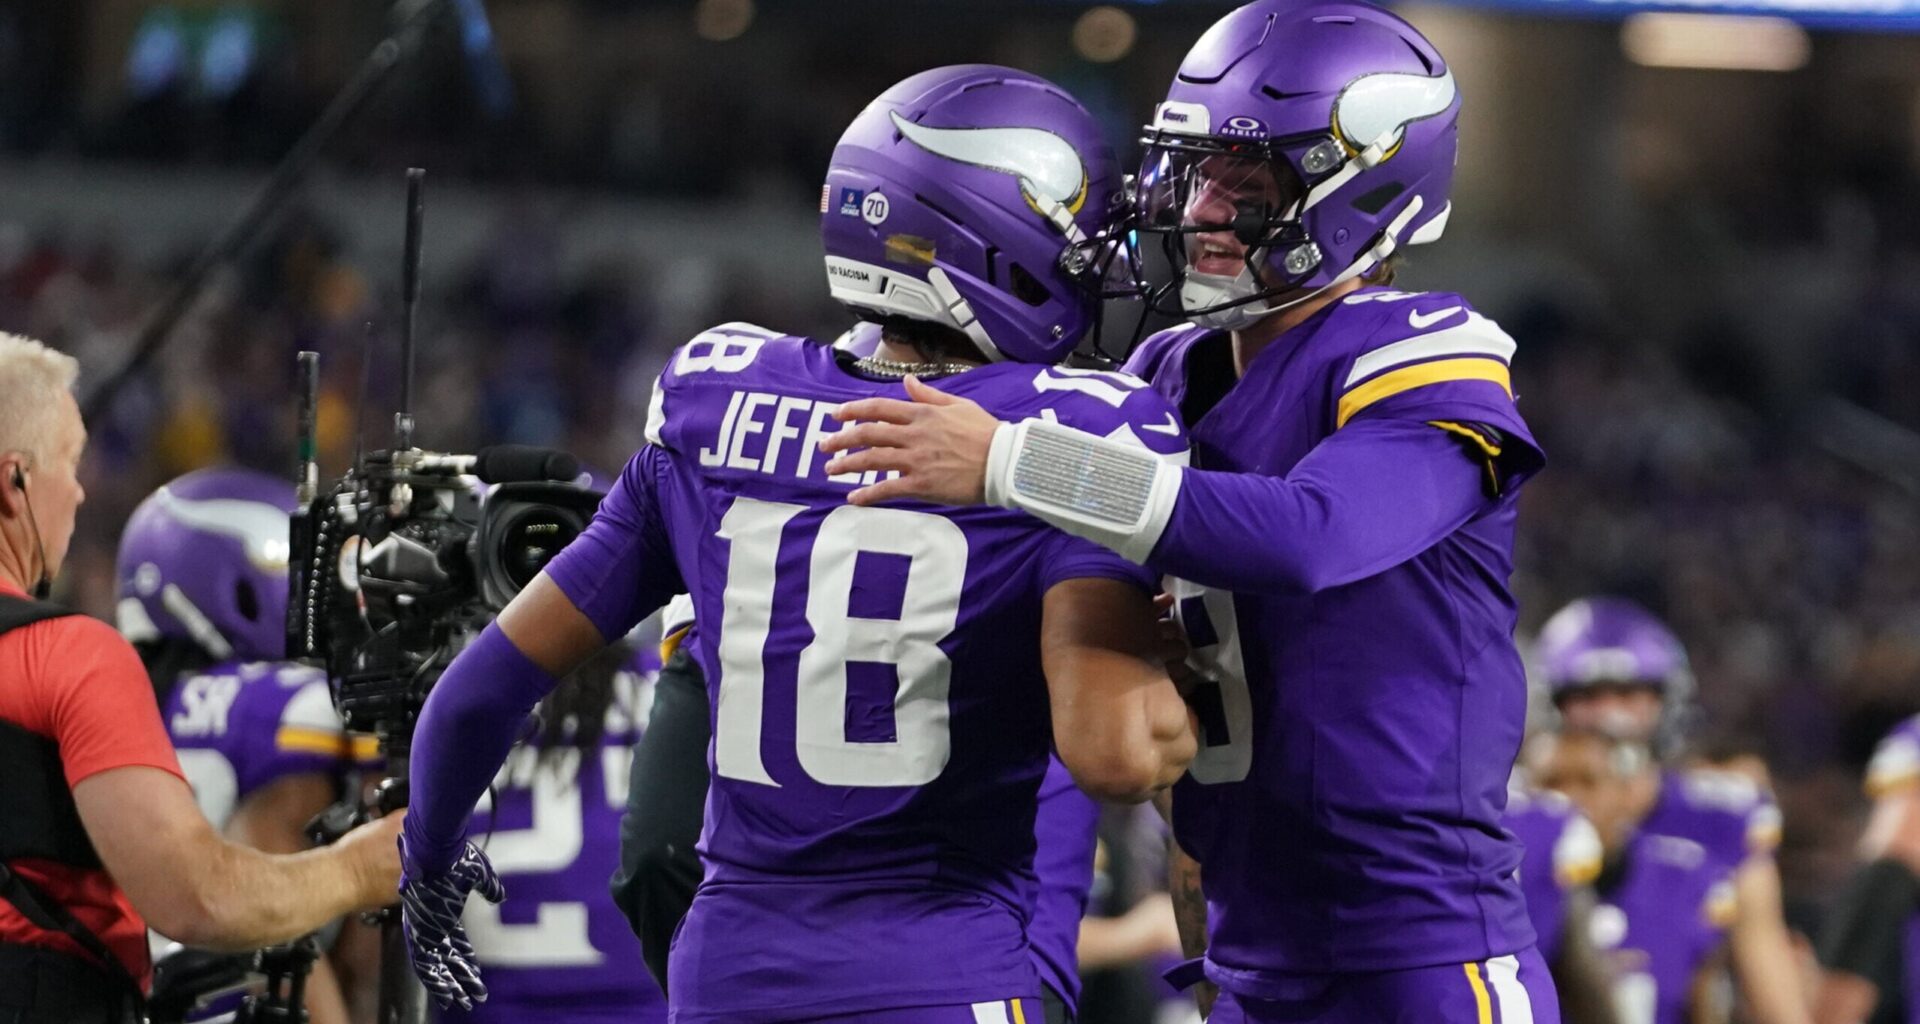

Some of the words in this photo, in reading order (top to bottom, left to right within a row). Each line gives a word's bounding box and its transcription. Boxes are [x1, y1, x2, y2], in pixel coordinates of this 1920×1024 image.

[1221, 127, 1266, 138] OAKLEY
[866, 198, 885, 218] 70
[838, 266, 871, 282] RACISM
[714, 496, 969, 788] 18
